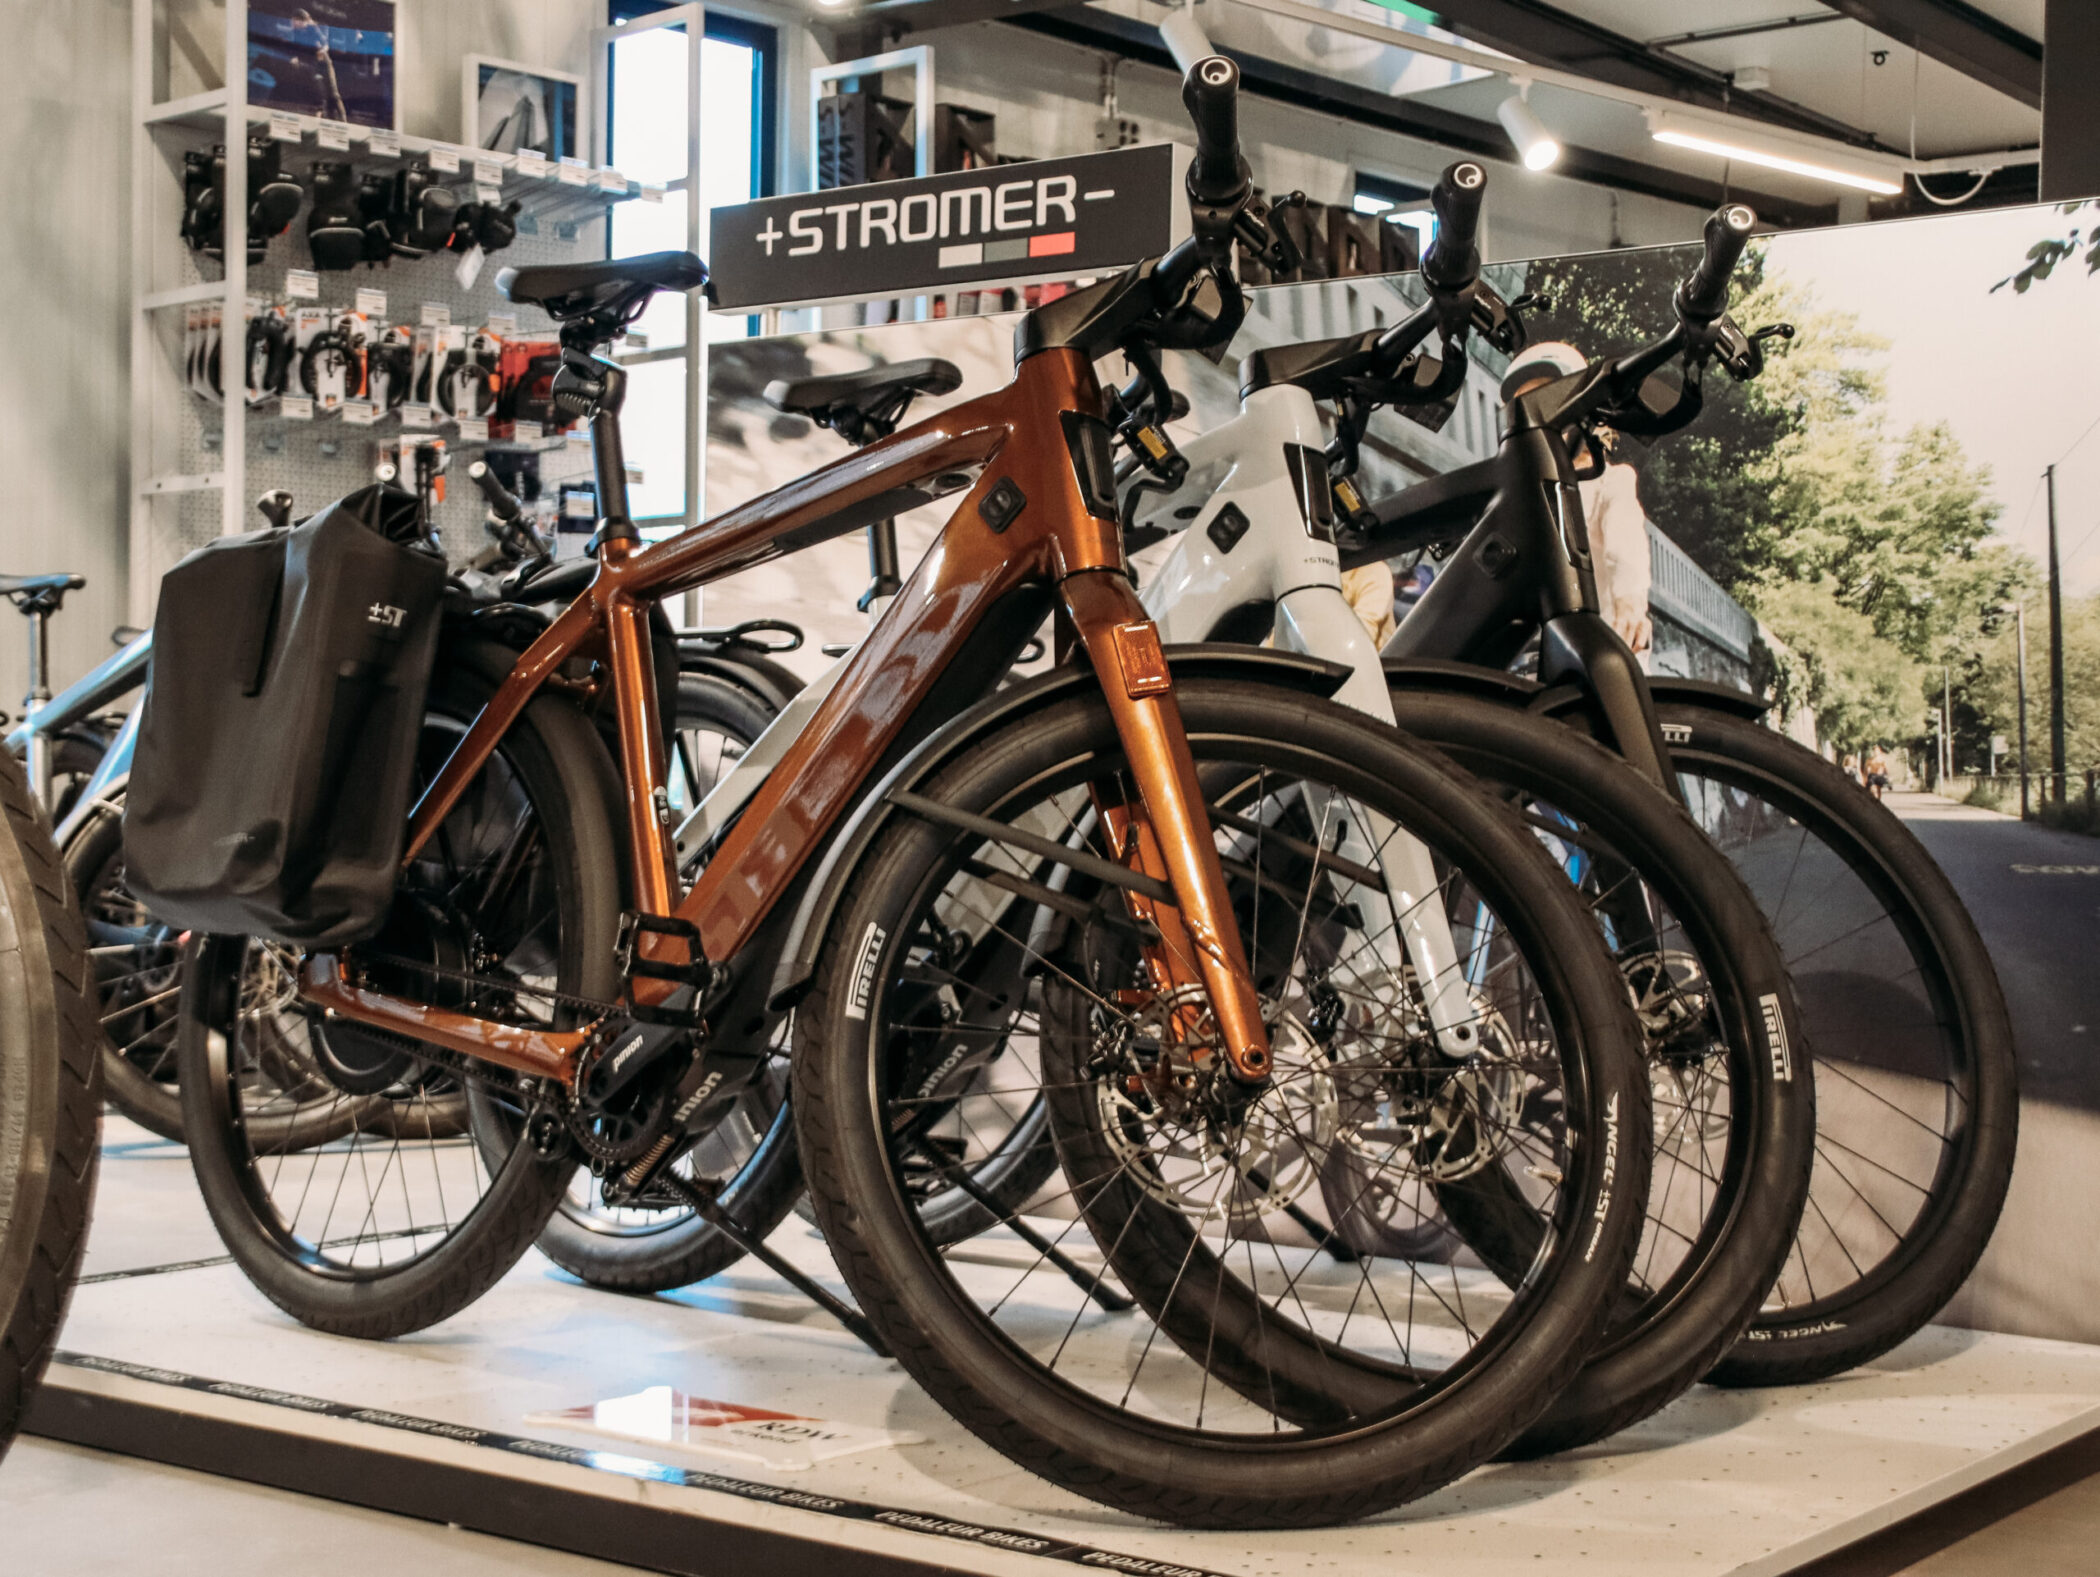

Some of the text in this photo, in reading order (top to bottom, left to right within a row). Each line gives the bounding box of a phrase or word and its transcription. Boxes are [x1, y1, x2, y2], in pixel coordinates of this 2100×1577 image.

[845, 921, 887, 1021] PIRELLI
[612, 1034, 643, 1074] pinion
[1759, 992, 1793, 1082] PIRELLI
[674, 1071, 722, 1121] inion
[874, 1511, 1050, 1550] PEDALEUR BIKES
[1082, 1551, 1202, 1577] PEDALEUR
